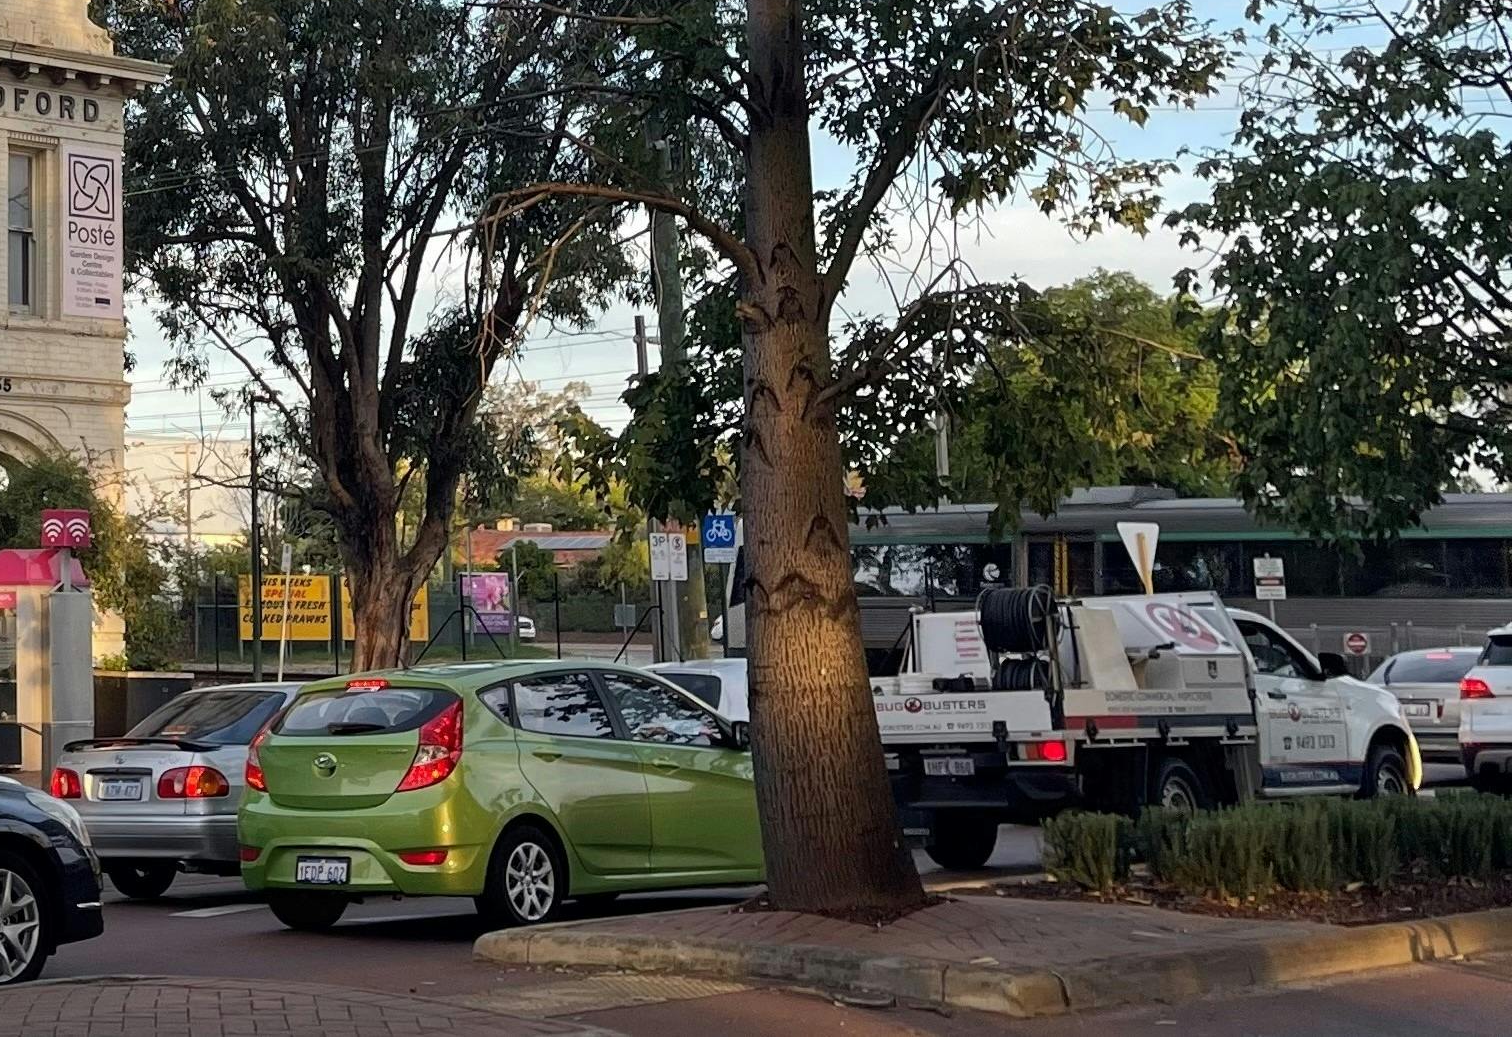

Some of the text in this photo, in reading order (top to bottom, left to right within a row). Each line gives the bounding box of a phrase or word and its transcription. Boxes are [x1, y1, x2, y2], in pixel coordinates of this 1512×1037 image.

[68, 221, 115, 246] Posté
[264, 589, 307, 598] SPEIAL
[877, 700, 986, 712] BUG BUSTERS
